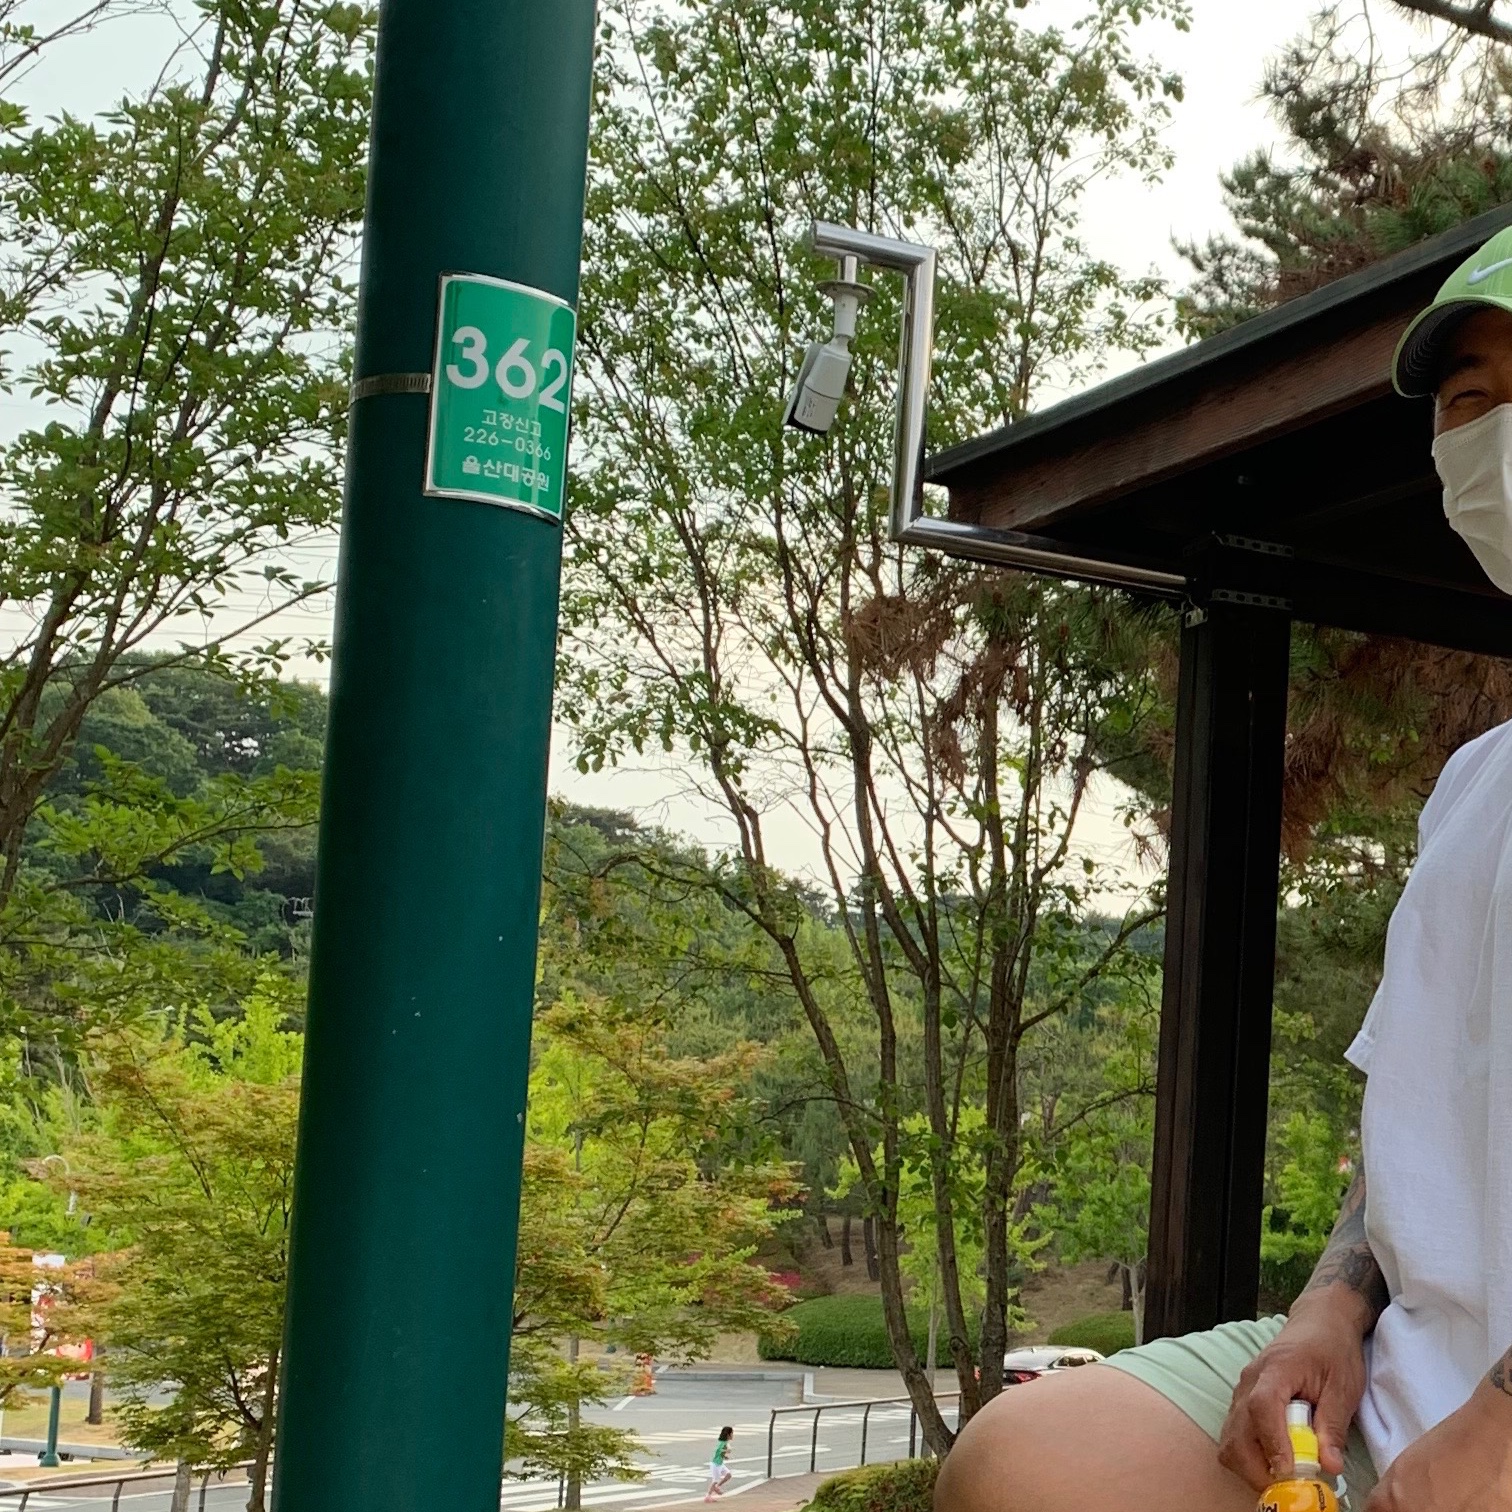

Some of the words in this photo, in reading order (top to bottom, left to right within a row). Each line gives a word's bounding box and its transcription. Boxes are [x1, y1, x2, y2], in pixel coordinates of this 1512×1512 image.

[446, 326, 568, 414] 362
[481, 409, 542, 437] 고장신고
[463, 426, 551, 461] 226-0366
[462, 455, 550, 492] 울산대공원
